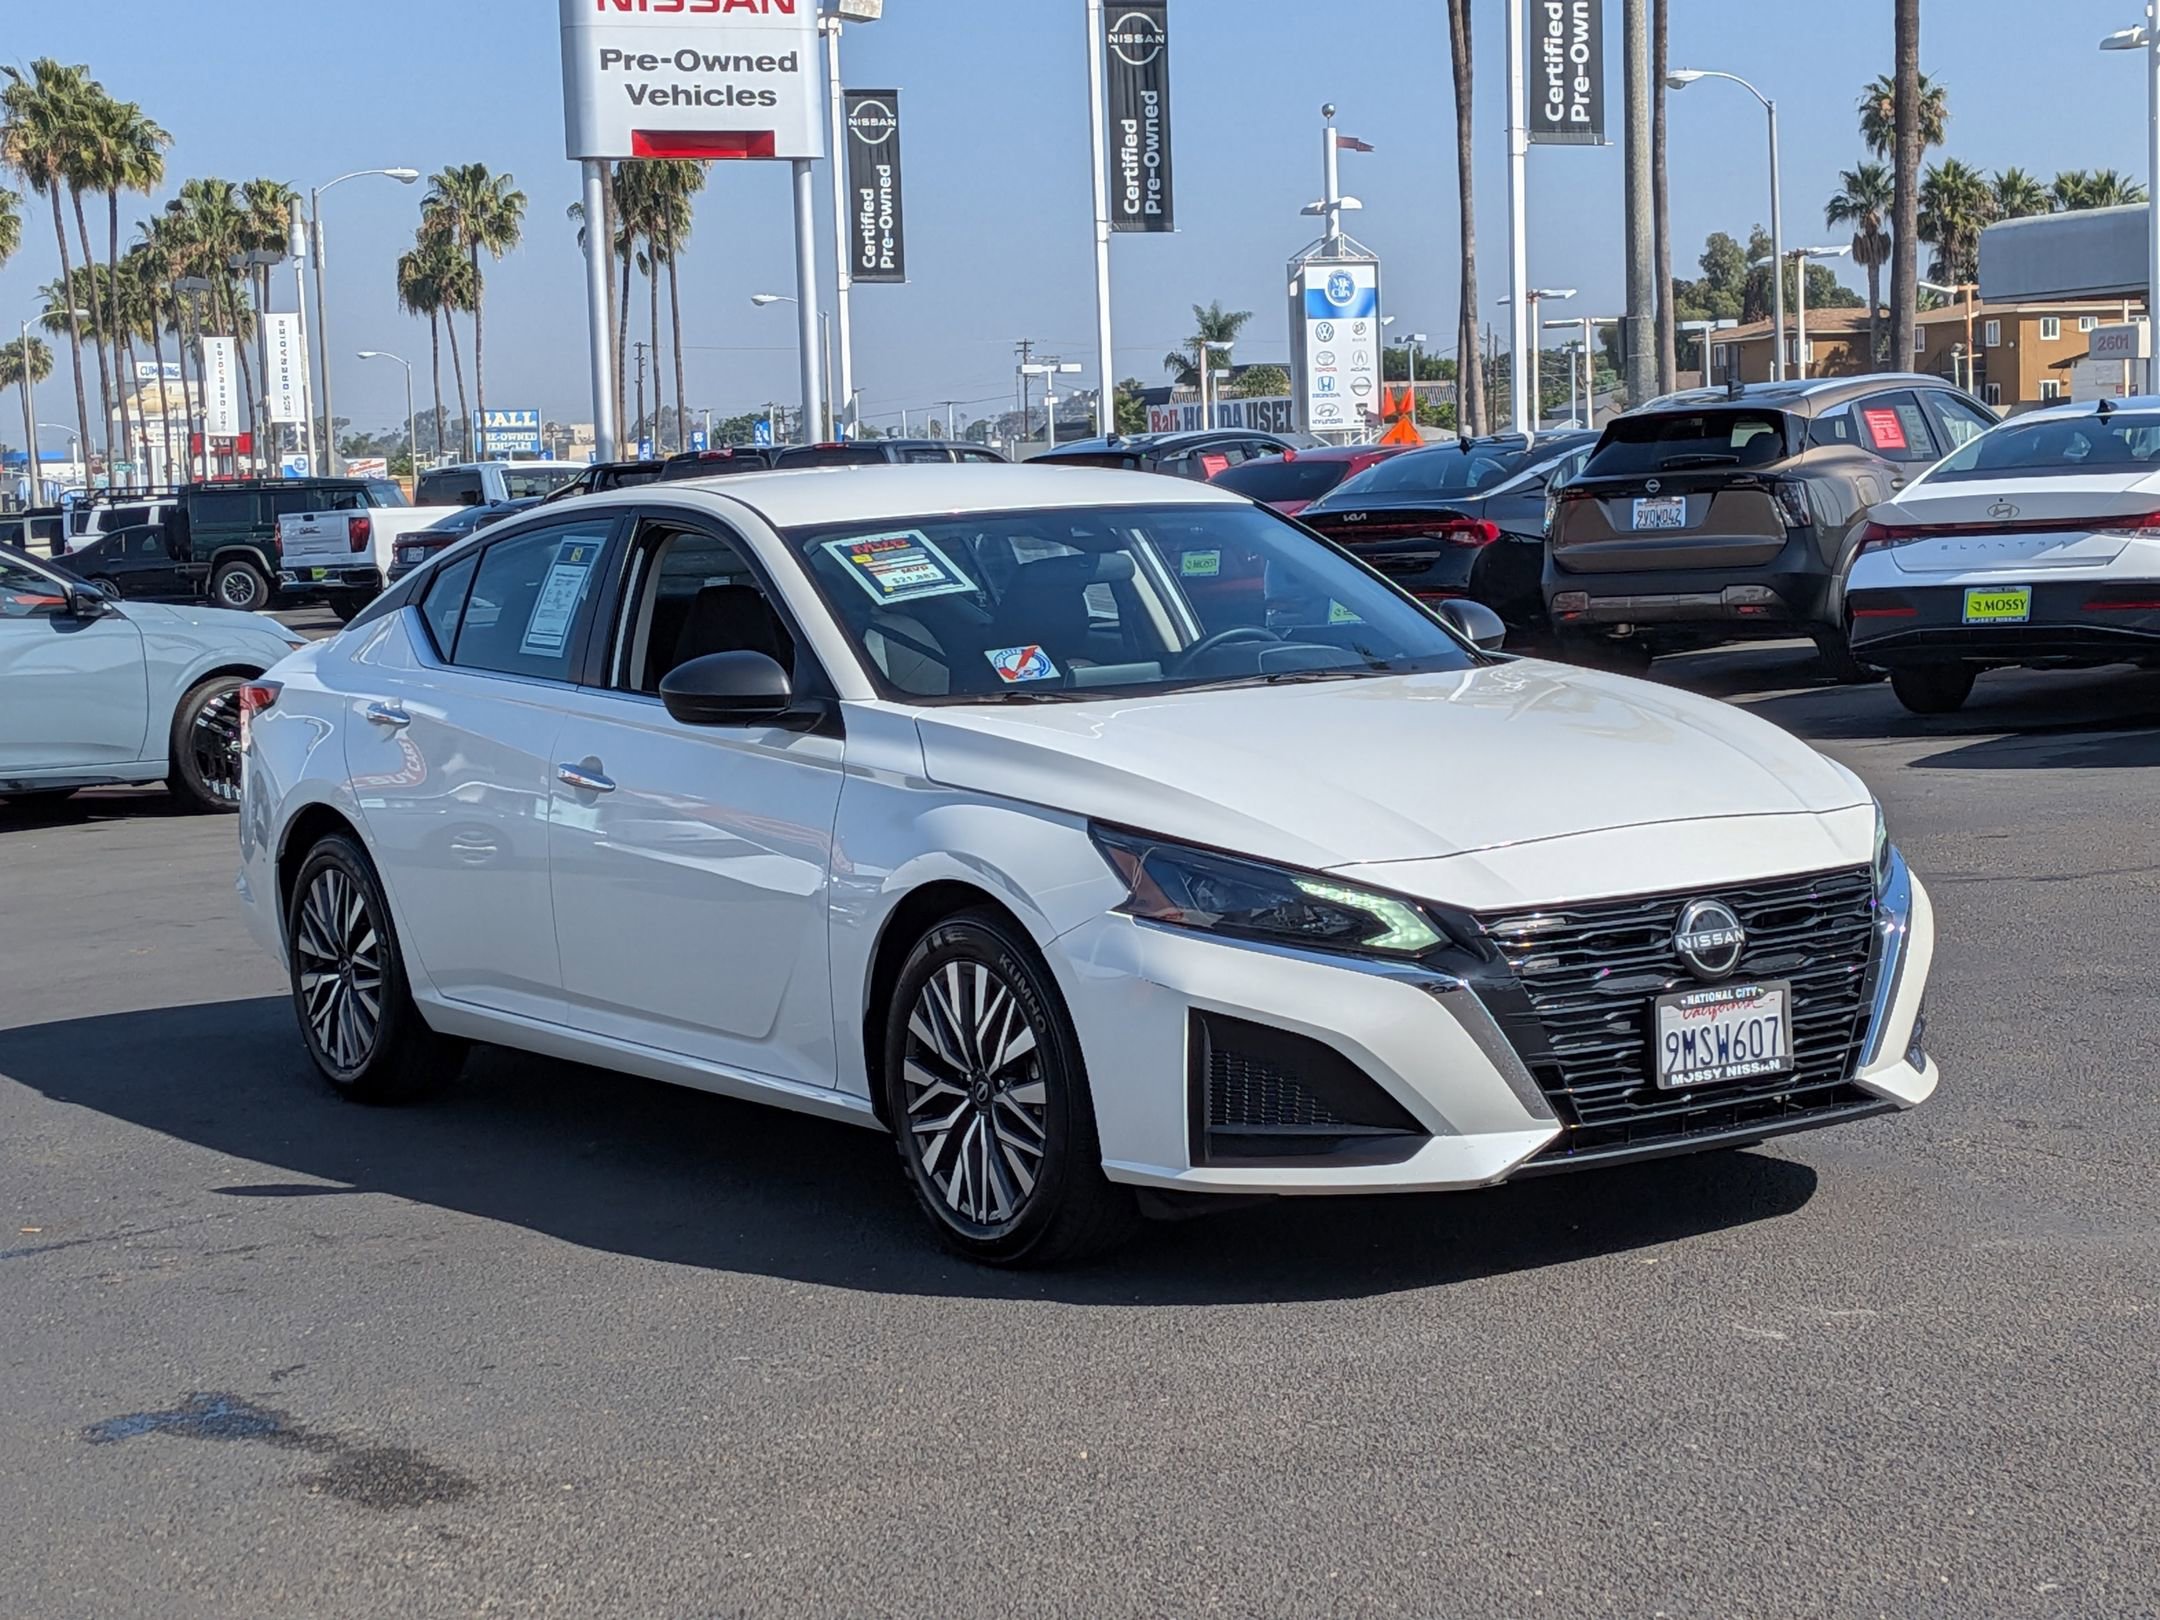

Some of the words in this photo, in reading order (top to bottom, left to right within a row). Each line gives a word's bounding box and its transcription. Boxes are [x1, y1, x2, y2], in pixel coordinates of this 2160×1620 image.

[1108, 34, 1165, 44] NISSAN
[600, 49, 798, 72] Pre-Owned
[1544, 1, 1564, 121] Certified
[625, 84, 777, 106] Vehicles
[848, 117, 897, 127] NISSAN
[1140, 91, 1162, 215] Pre-Owned
[1121, 119, 1141, 215] Certified
[860, 188, 876, 269] Certified
[876, 165, 895, 269] Pre-Owned
[2097, 333, 2129, 352] 2601
[1941, 540, 2067, 550] ELANTRA
[1983, 598, 2027, 611] MOSSY
[1677, 928, 1745, 951] NISSAN
[1000, 953, 1046, 1034] KUMHO
[1687, 989, 1733, 1005] NATIONAL
[1736, 986, 1758, 999] CITY
[1665, 1016, 1779, 1073] 9MSW607
[1671, 1067, 1723, 1085] MOSSY
[1726, 1058, 1781, 1077] NISSAN
